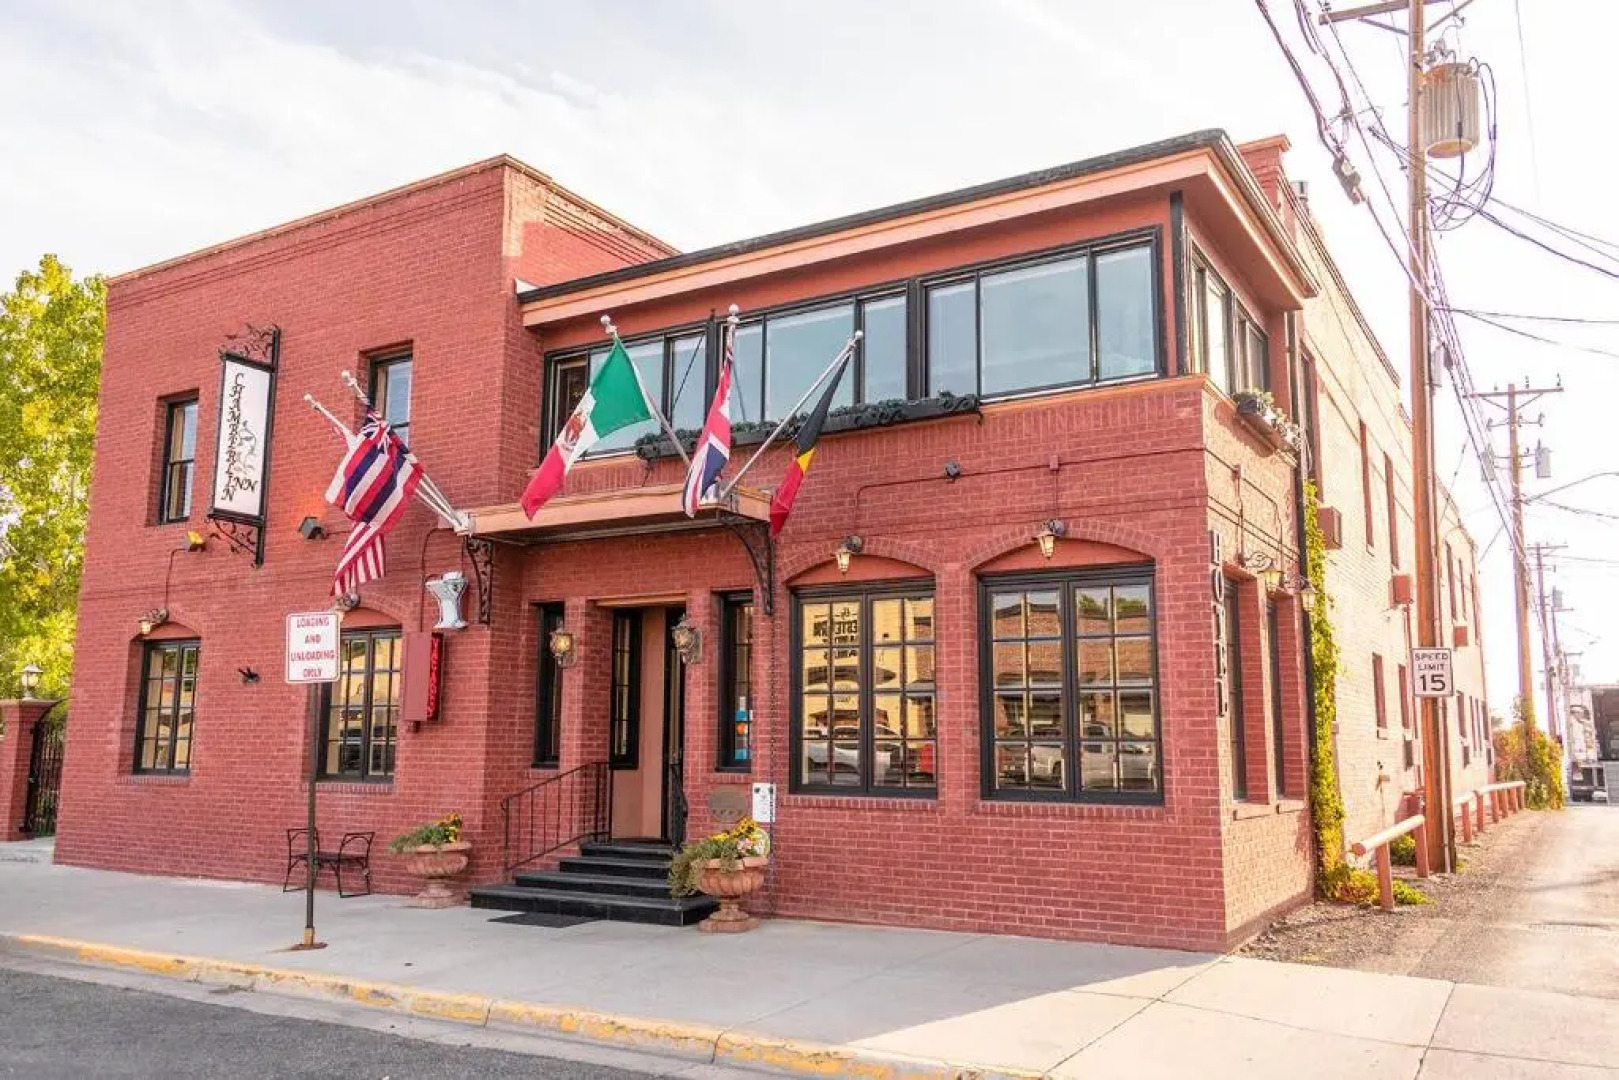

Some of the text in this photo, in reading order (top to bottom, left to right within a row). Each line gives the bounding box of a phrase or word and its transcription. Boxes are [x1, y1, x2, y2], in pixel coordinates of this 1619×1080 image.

[221, 372, 245, 502] CHAMBERLIN
[297, 616, 330, 628] LOADING
[305, 634, 321, 644] AND
[291, 649, 335, 662] UNLOADING
[1415, 652, 1449, 661] SPEED
[303, 667, 322, 678] ONLY
[1418, 663, 1445, 671] LIMIT
[1420, 674, 1446, 692] 15
